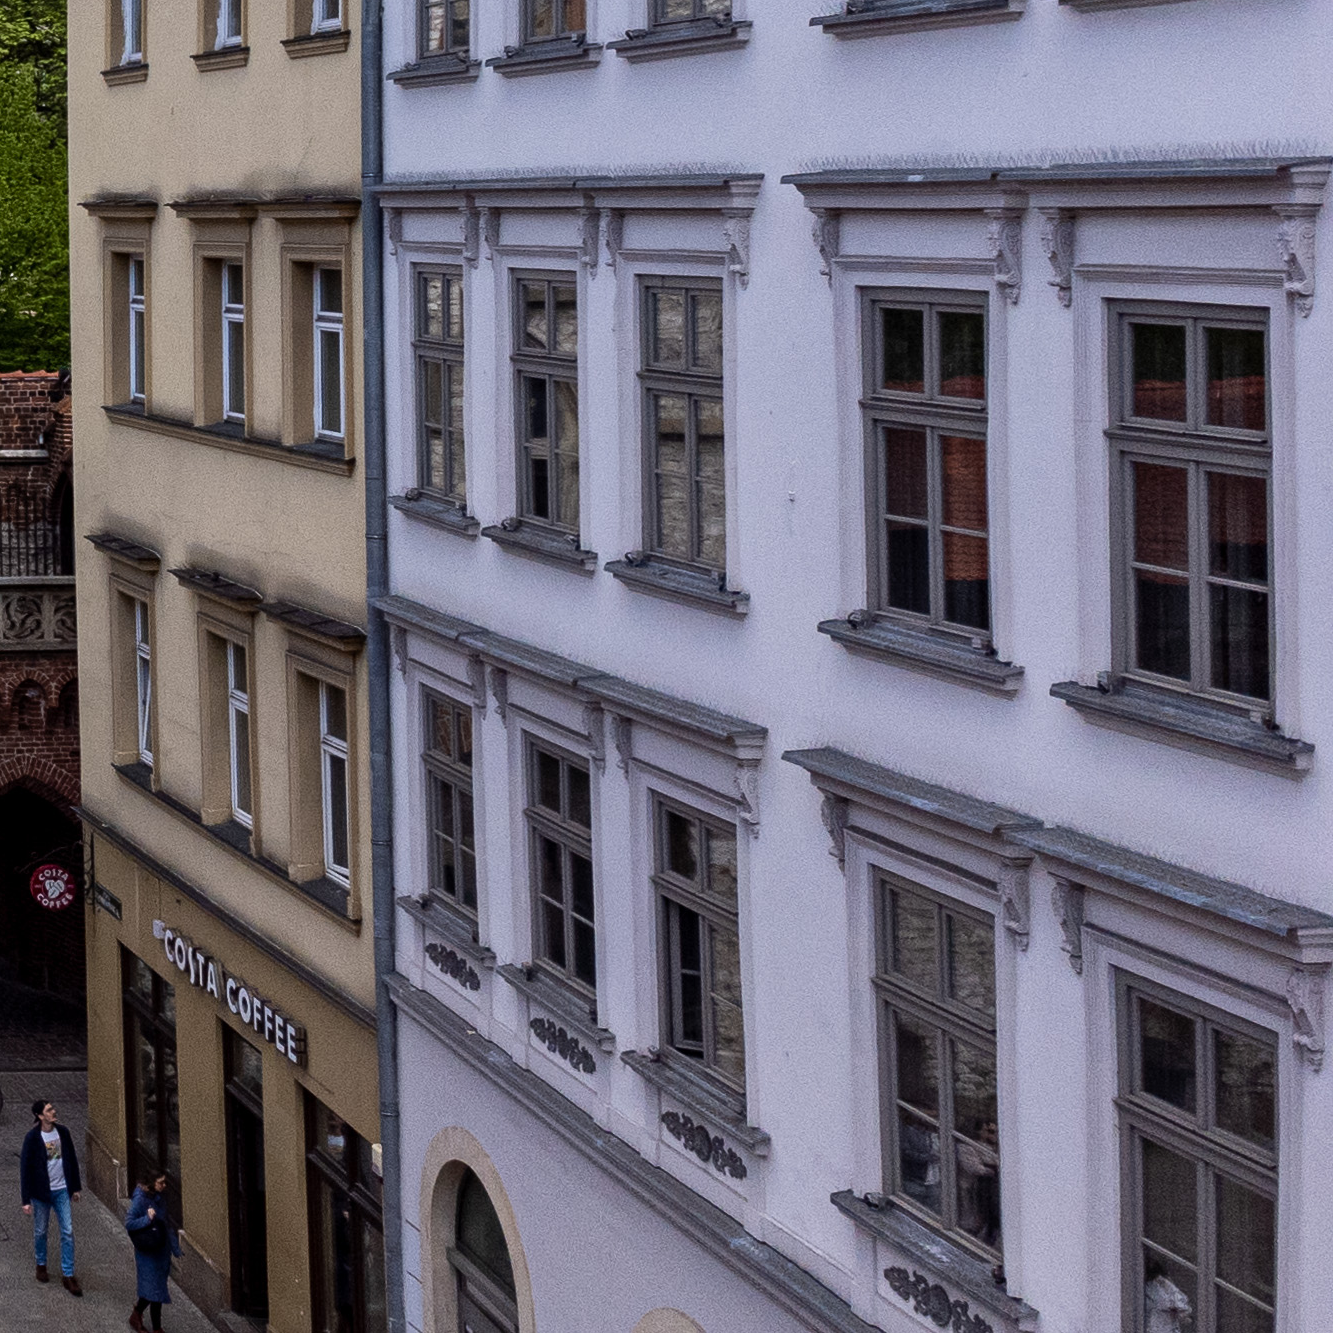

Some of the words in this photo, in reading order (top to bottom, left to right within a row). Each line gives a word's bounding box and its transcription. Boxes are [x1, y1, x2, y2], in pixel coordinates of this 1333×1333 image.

[38, 868, 69, 881] COSTA
[36, 893, 74, 908] COFFEE
[164, 929, 218, 999] COSTA
[226, 978, 298, 1064] COFFEE
